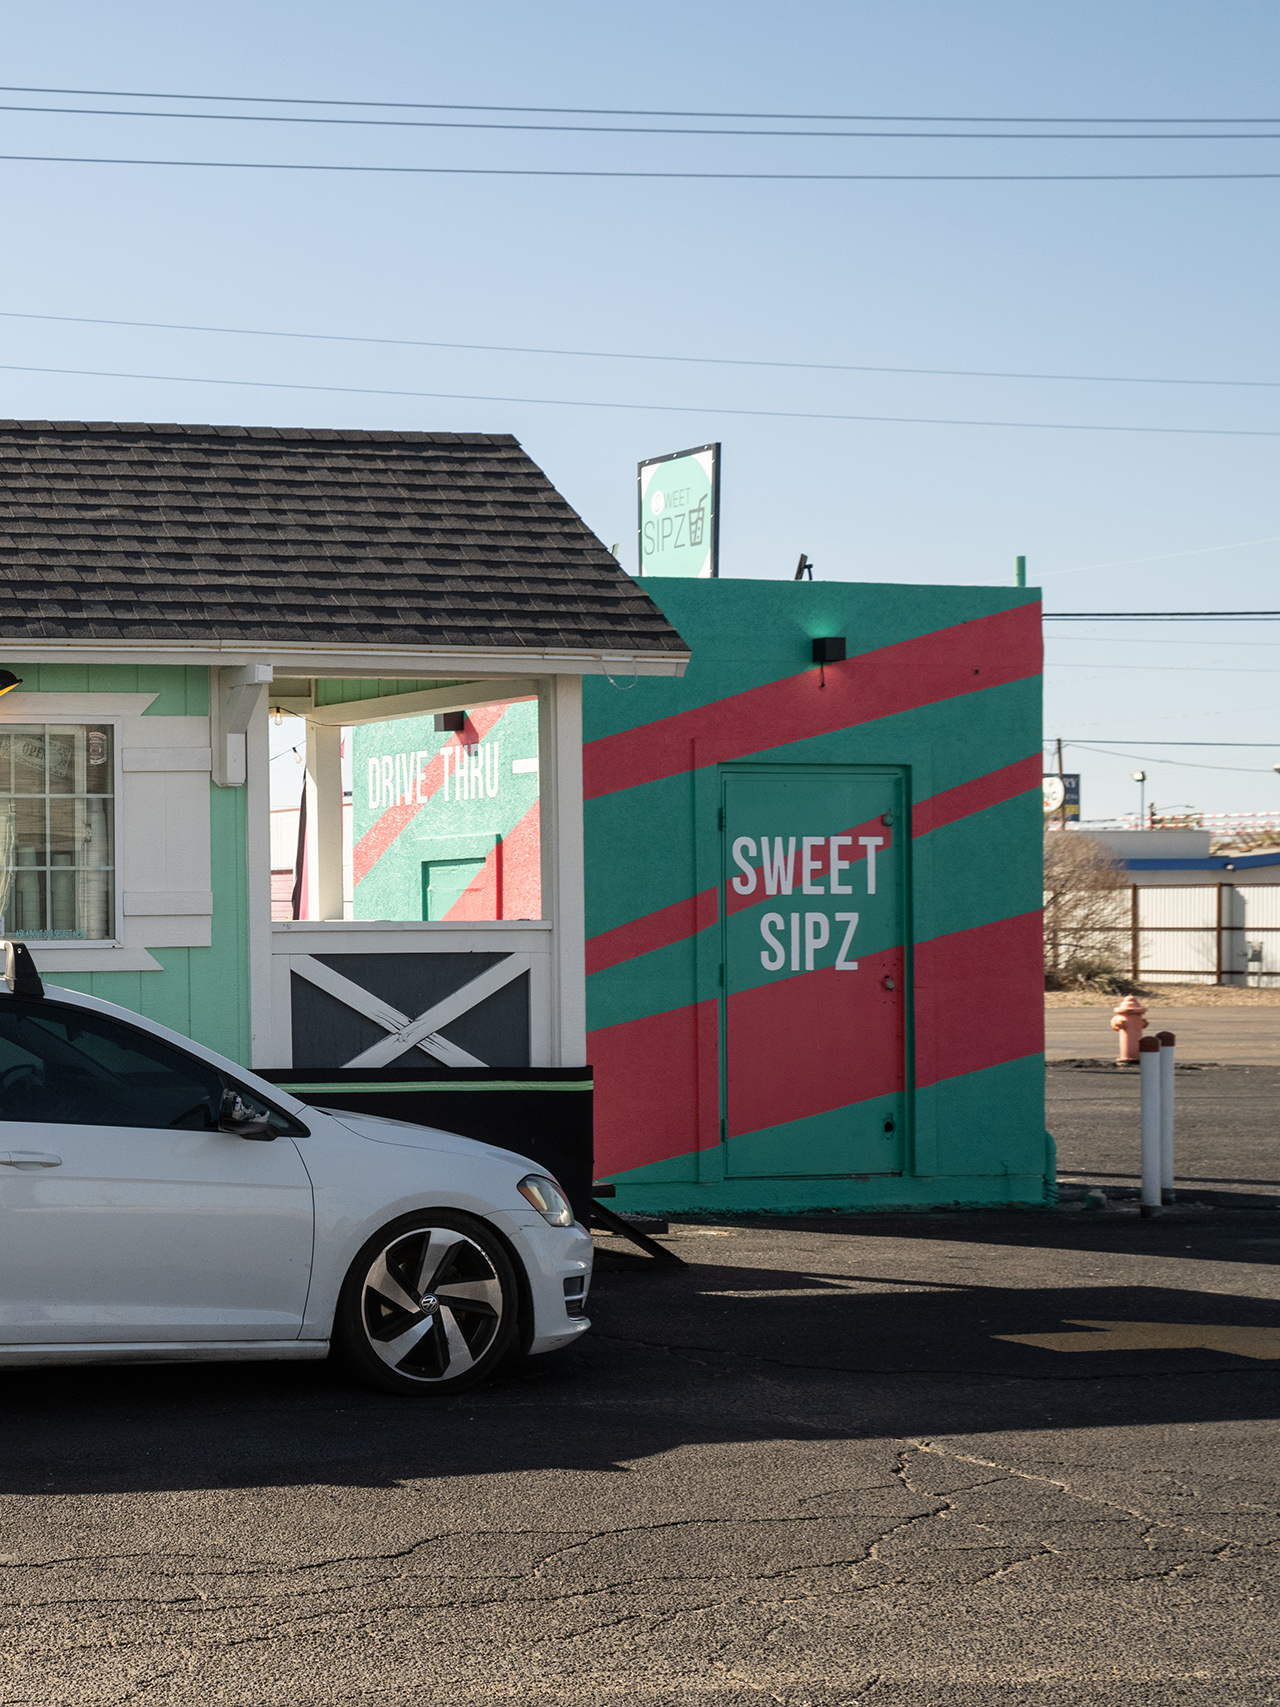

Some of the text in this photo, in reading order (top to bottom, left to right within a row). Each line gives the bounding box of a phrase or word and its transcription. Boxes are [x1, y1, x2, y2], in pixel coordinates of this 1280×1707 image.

[652, 487, 691, 514] SWEET
[643, 513, 686, 556] SIPZ
[368, 741, 499, 810] DRIVE THRU
[732, 836, 884, 896] SWEET
[16, 930, 87, 939] ASK ABOUT OUR SECRET MENU
[760, 912, 859, 971] SIPZ
